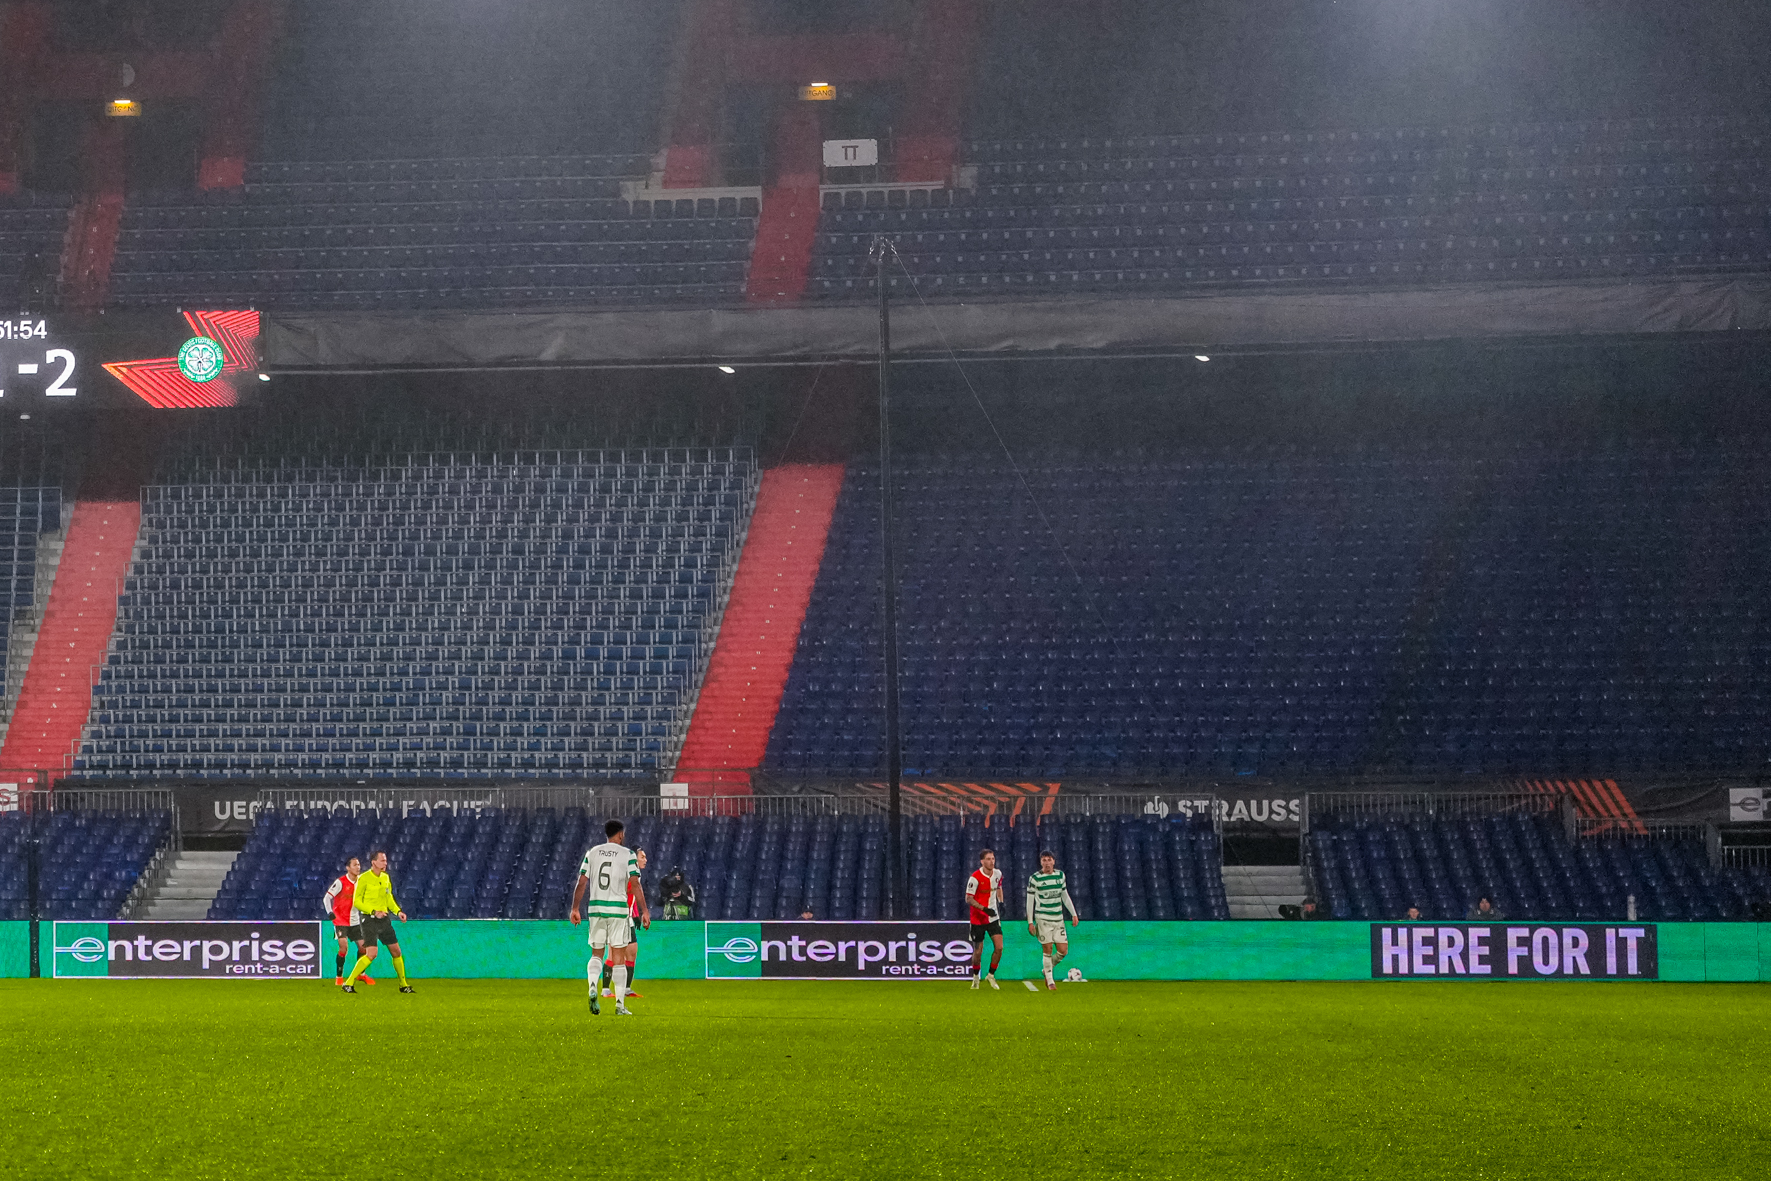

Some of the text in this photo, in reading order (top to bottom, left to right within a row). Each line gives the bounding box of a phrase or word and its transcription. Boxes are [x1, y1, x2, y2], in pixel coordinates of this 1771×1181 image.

[598, 849, 619, 858] TRUSTY
[598, 861, 612, 891] 6
[70, 932, 316, 970] enterprise
[724, 932, 974, 970] enterprise
[1382, 927, 1492, 975] HERE
[1507, 927, 1591, 975] FOR
[225, 962, 315, 974] rent-a-car
[881, 963, 973, 975] rent-a-car
